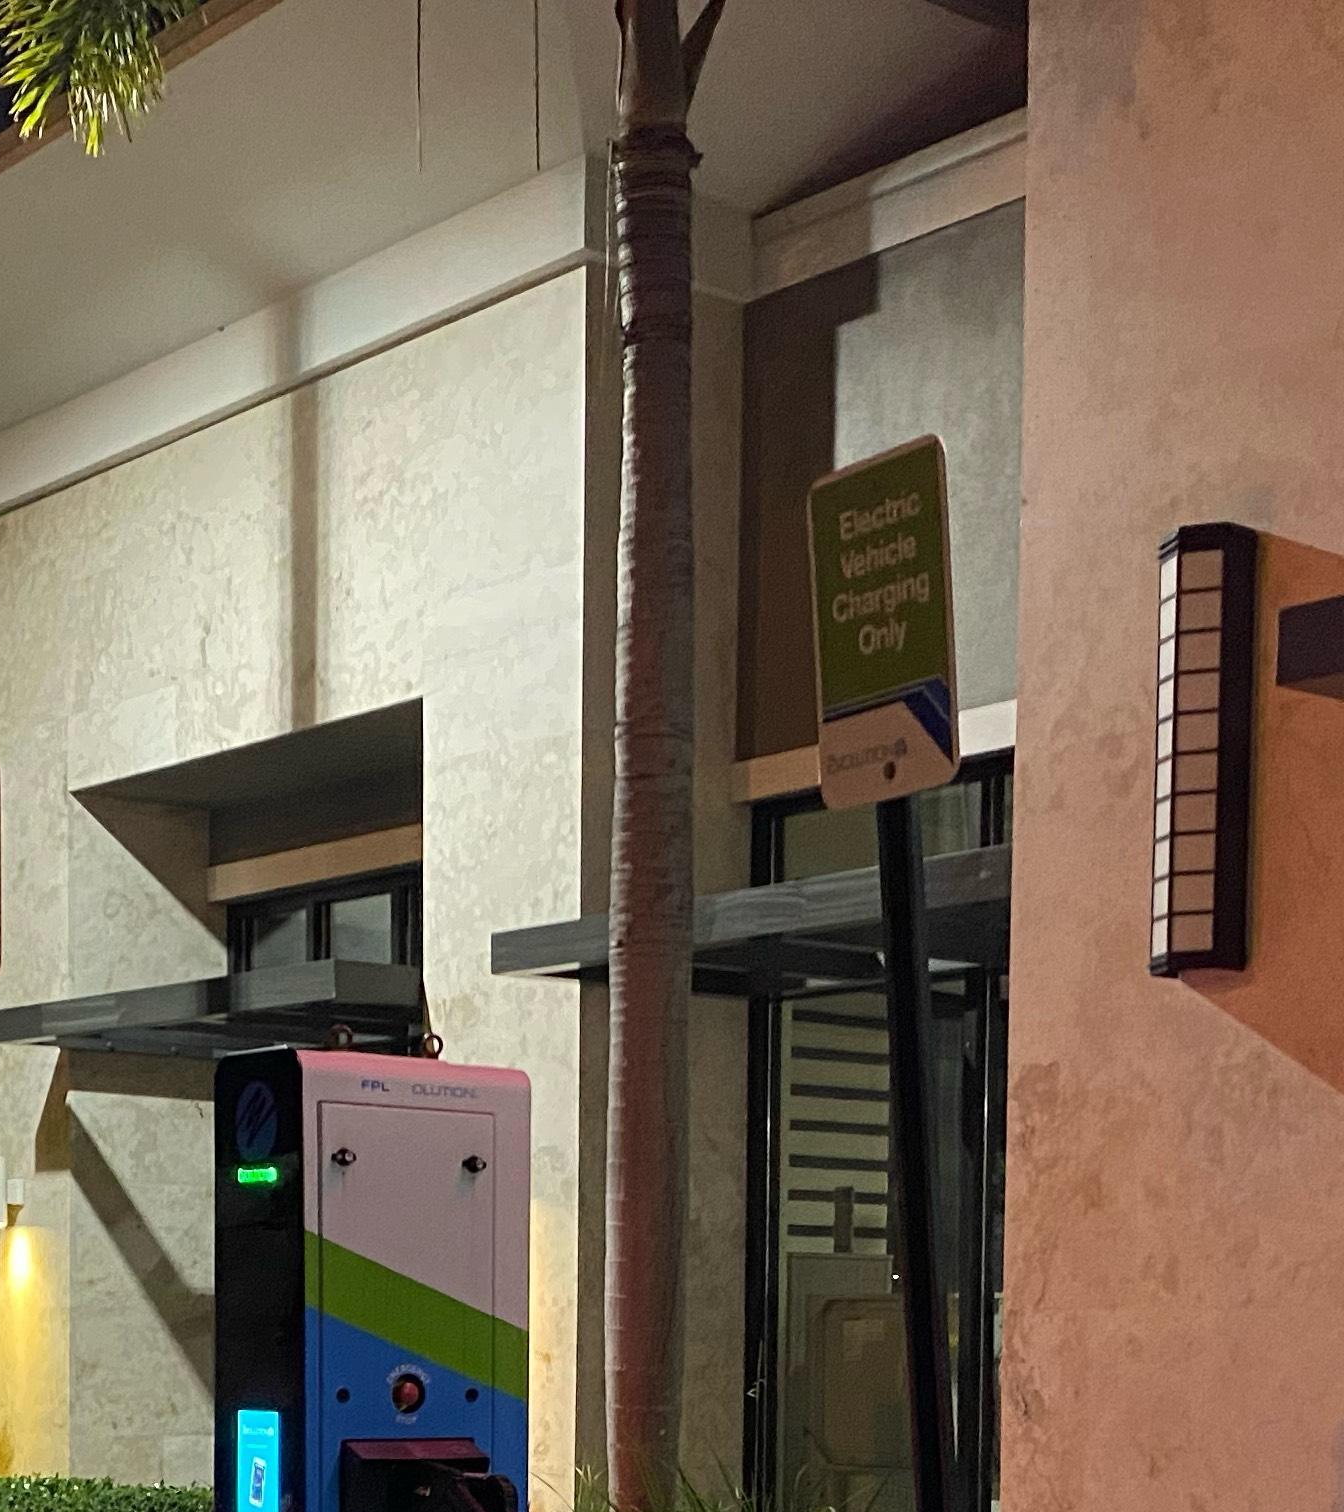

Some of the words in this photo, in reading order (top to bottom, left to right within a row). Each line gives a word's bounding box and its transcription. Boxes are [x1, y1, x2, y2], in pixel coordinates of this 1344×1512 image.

[839, 491, 921, 541] Electric
[840, 533, 917, 579] Vehicle
[832, 571, 929, 623] Charging
[858, 618, 906, 655] Only
[361, 1079, 390, 1092] FPL
